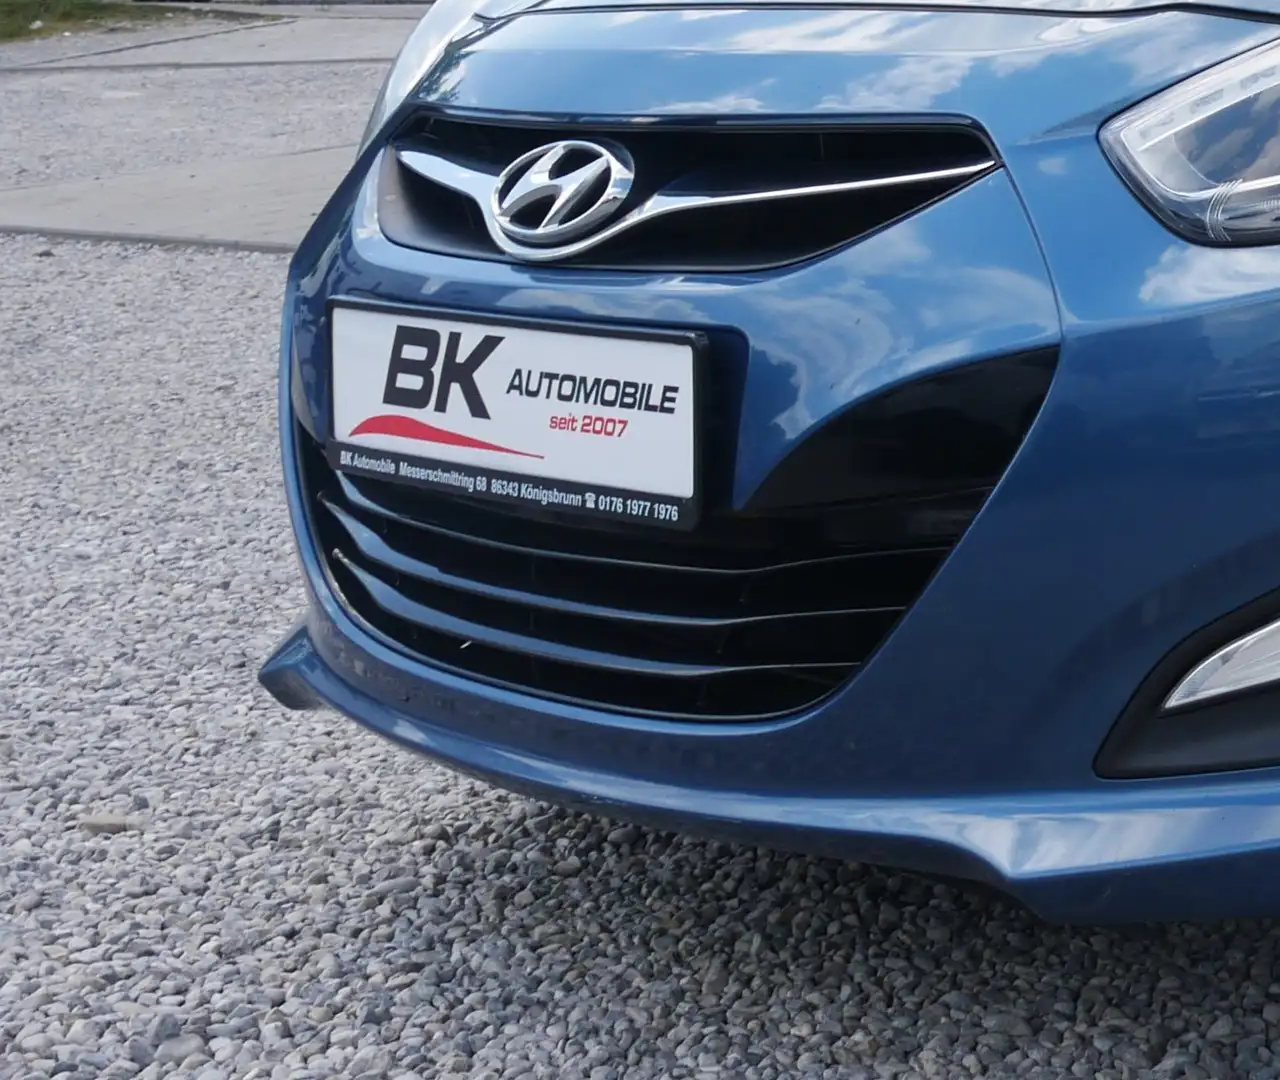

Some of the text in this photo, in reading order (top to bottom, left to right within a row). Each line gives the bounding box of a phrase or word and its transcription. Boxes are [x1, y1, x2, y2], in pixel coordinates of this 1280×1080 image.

[382, 324, 506, 420] BK
[506, 368, 680, 414] AUTOMOBILE
[549, 413, 629, 437] seit 2007
[340, 450, 679, 521] BK Automobile Messerschmittring 68 86343 Königsbrunn 0176 1977 1976
